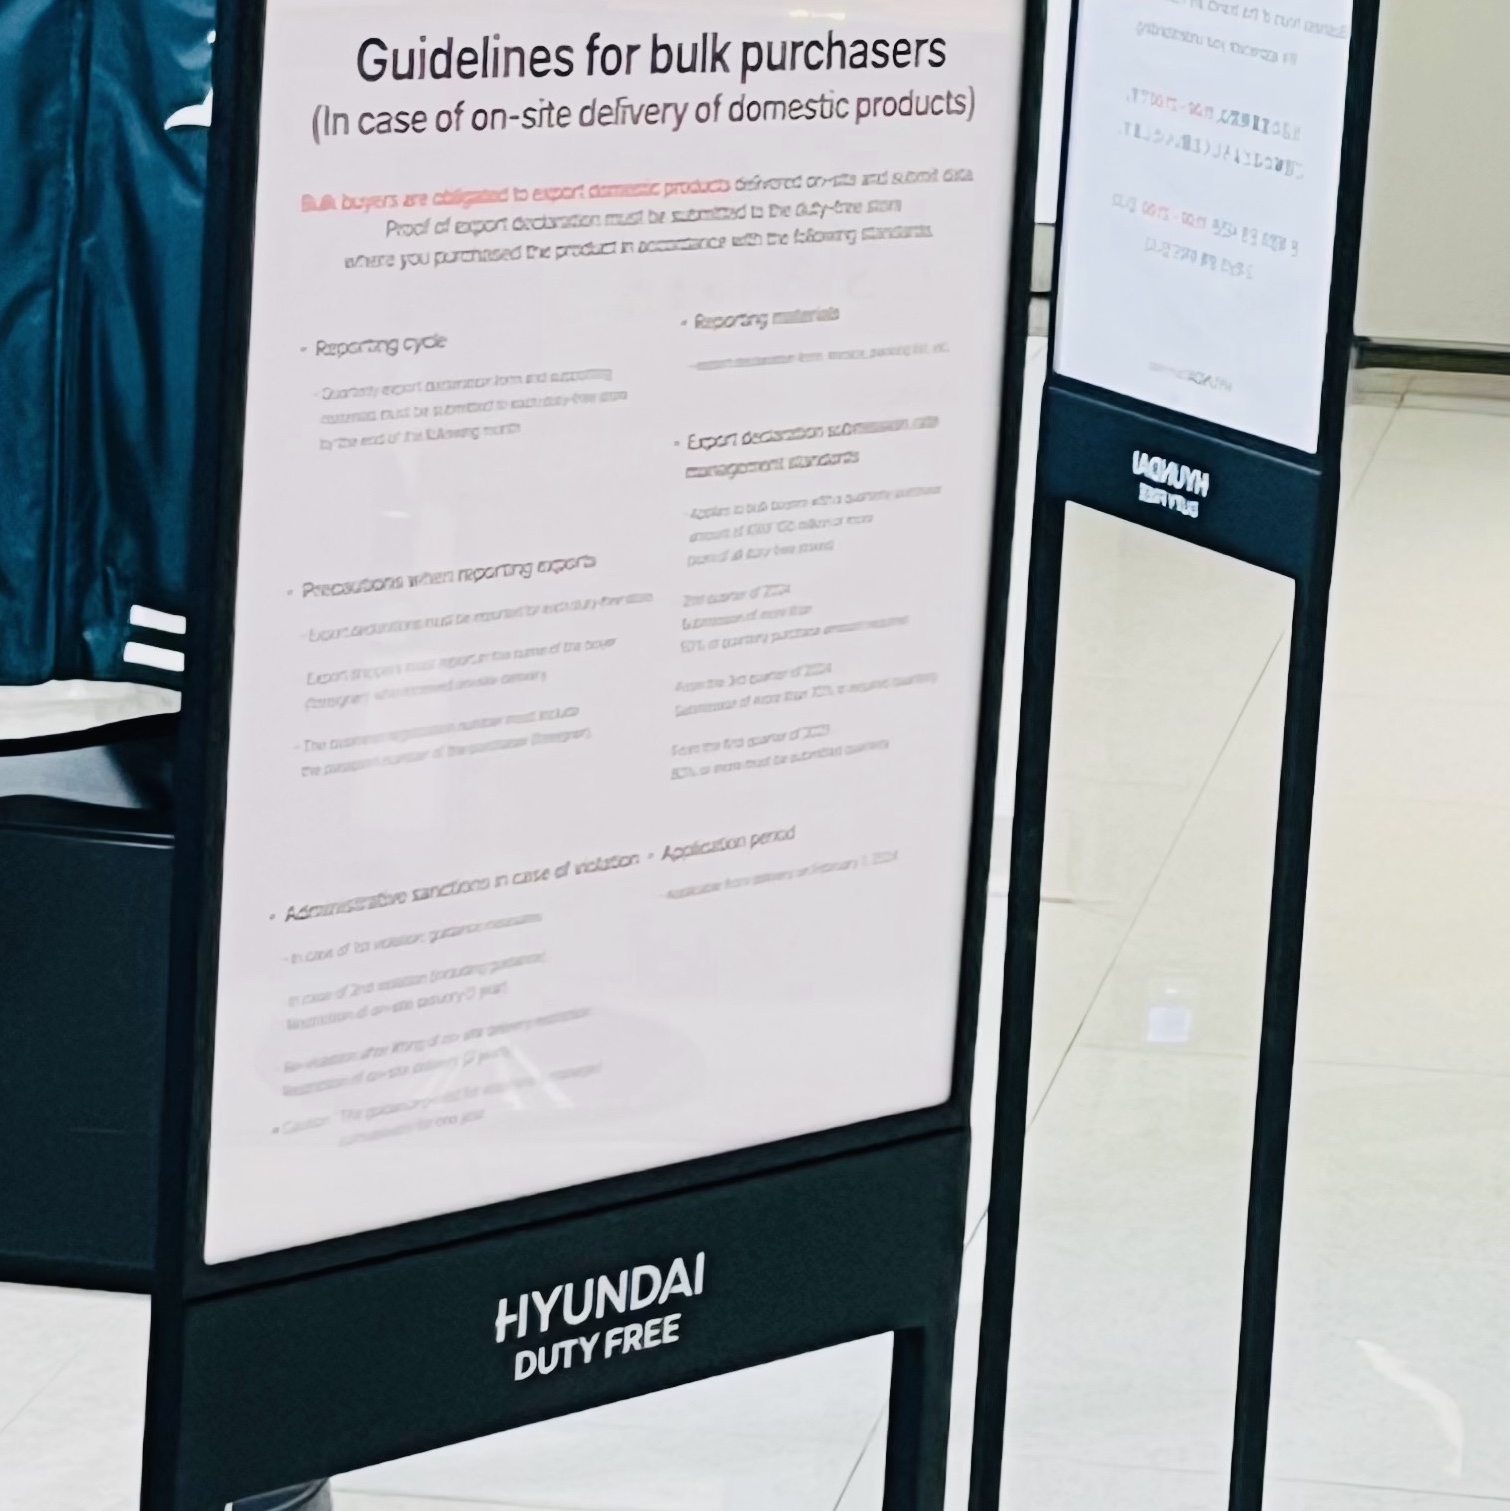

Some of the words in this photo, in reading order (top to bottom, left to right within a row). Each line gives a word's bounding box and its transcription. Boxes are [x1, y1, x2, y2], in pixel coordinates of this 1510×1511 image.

[357, 33, 574, 82] Guidelines
[586, 32, 641, 76] for
[650, 32, 731, 74] bulk
[741, 30, 946, 84] purchasers
[312, 104, 349, 145] (In
[358, 109, 428, 135] case
[435, 100, 465, 132] of
[471, 98, 572, 132] on-site
[579, 93, 688, 132] delivery
[695, 92, 723, 123] of
[728, 90, 850, 122] domestic
[855, 85, 975, 125] products)
[341, 193, 399, 213] buyers
[512, 187, 529, 202] to
[532, 184, 585, 203] export
[386, 217, 431, 238] Proof
[434, 216, 451, 235] of
[455, 217, 508, 237] export
[648, 210, 666, 224] be
[399, 252, 430, 271] you
[555, 241, 617, 260] product
[695, 313, 768, 331] Reporting
[315, 338, 399, 358] Reporting
[403, 333, 447, 355] cycle
[687, 433, 738, 451] Export
[302, 576, 404, 598] Precautions
[407, 571, 454, 588] when
[458, 562, 533, 583] reporting
[411, 877, 490, 902] sanctions
[494, 874, 509, 888] in
[512, 868, 551, 885] case
[554, 860, 571, 879] of
[495, 1252, 705, 1343] HYUNDAI
[514, 1332, 600, 1381] DUTY
[604, 1313, 682, 1359] FREE
